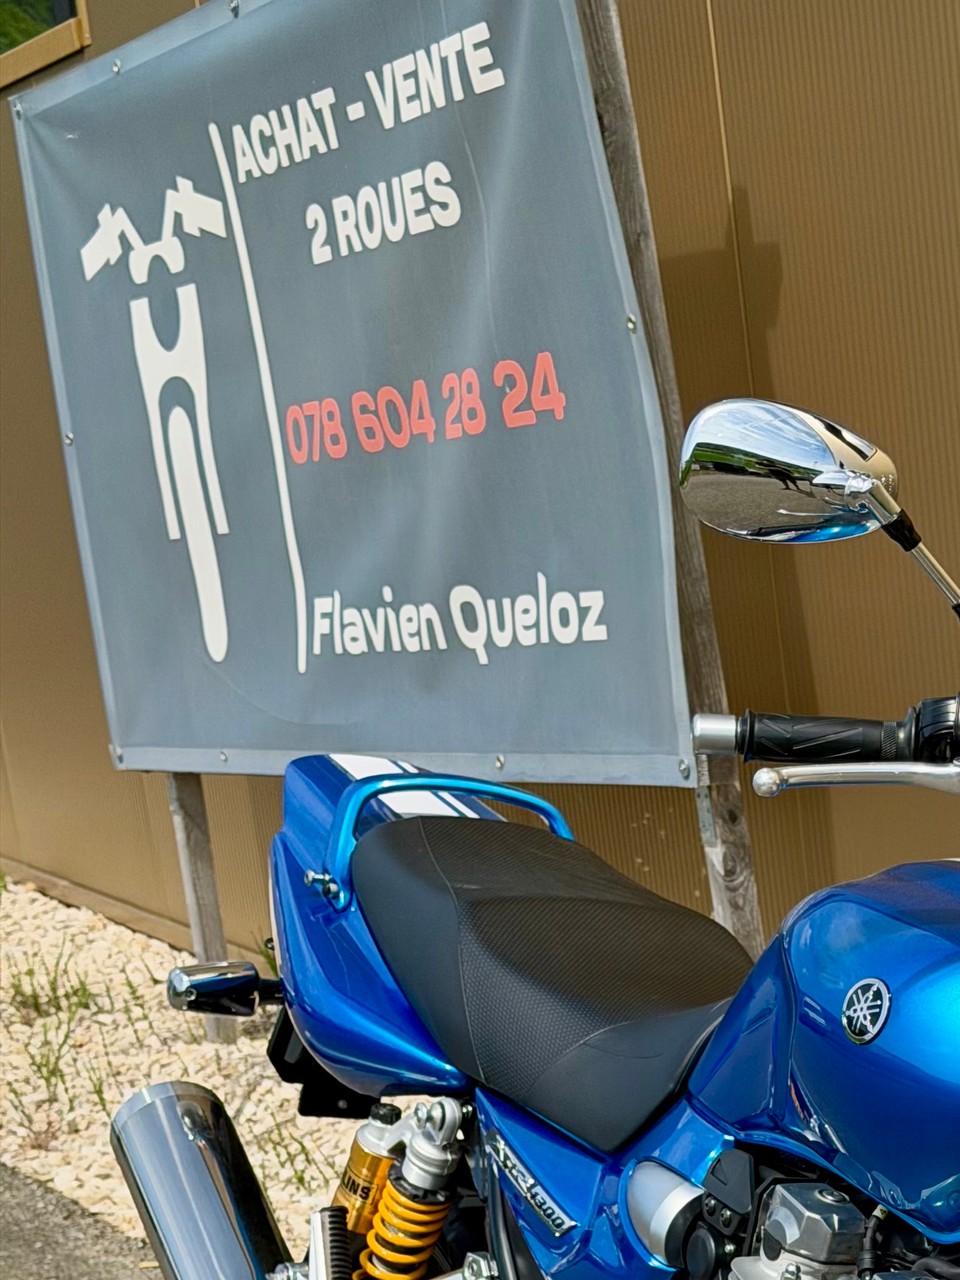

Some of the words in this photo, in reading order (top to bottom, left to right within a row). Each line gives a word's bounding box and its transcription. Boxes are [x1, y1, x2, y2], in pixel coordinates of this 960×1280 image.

[231, 86, 340, 184] ACHAT
[365, 21, 505, 131] VENTE
[305, 203, 333, 265] 2
[332, 160, 462, 258] ROUES
[285, 399, 348, 465] 078
[351, 379, 436, 454] 604
[442, 369, 486, 440] 28
[493, 351, 567, 429] 24
[312, 586, 448, 656] Flavien
[449, 571, 608, 666] Queloz
[341, 1167, 371, 1200] LINS
[530, 1190, 566, 1230] 1300
